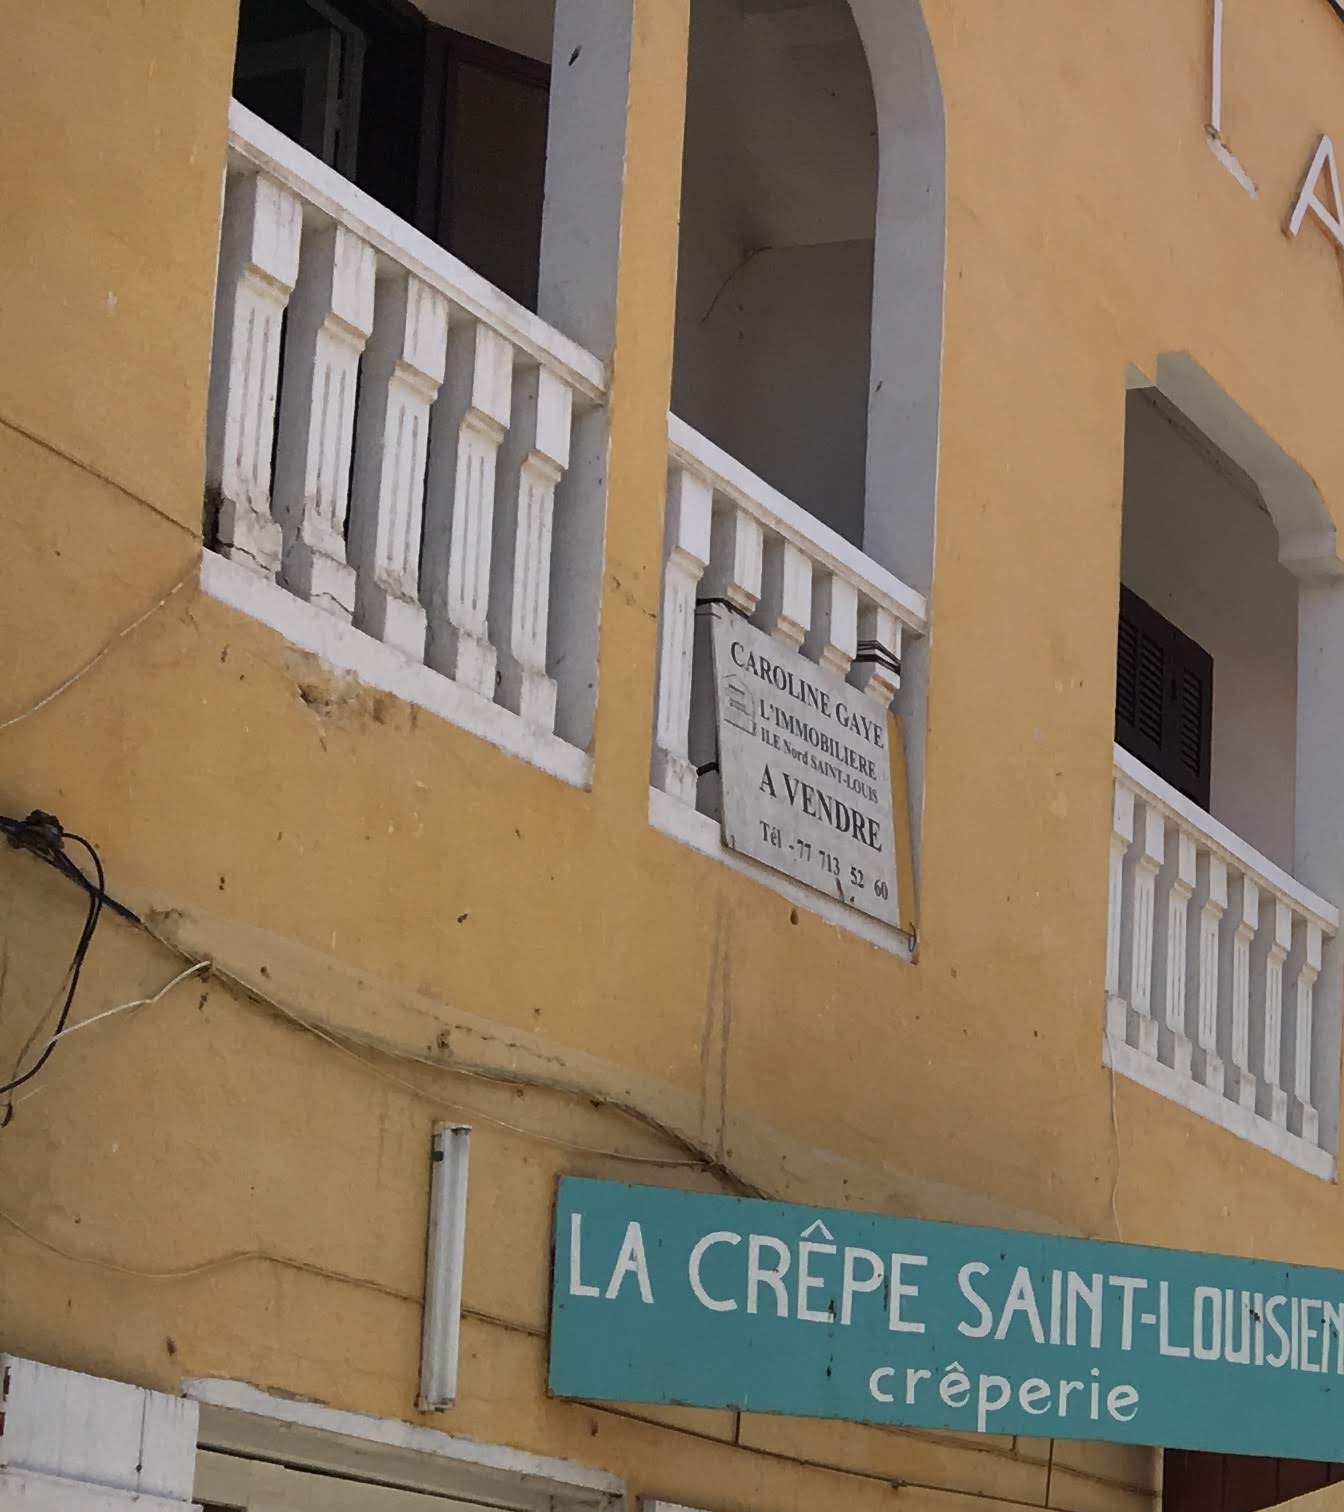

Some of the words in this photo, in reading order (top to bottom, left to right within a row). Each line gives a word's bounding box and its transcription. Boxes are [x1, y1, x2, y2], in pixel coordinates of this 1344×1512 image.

[731, 642, 831, 718] CAROLINE
[836, 703, 884, 749] GAYE
[760, 699, 877, 781] L'IMMOBILIERE
[761, 727, 780, 750] ILE
[784, 739, 808, 765] Nord
[811, 754, 878, 803] SAINT-LOUIS
[760, 763, 776, 798] A
[782, 772, 882, 852] VENDRE
[760, 820, 781, 848] Tél
[819, 850, 840, 875] 713
[850, 866, 864, 888] 52
[874, 880, 888, 900] 60
[569, 1213, 654, 1304] LA
[689, 1219, 928, 1334] CRÊPE
[869, 1361, 1140, 1432] crêperie
